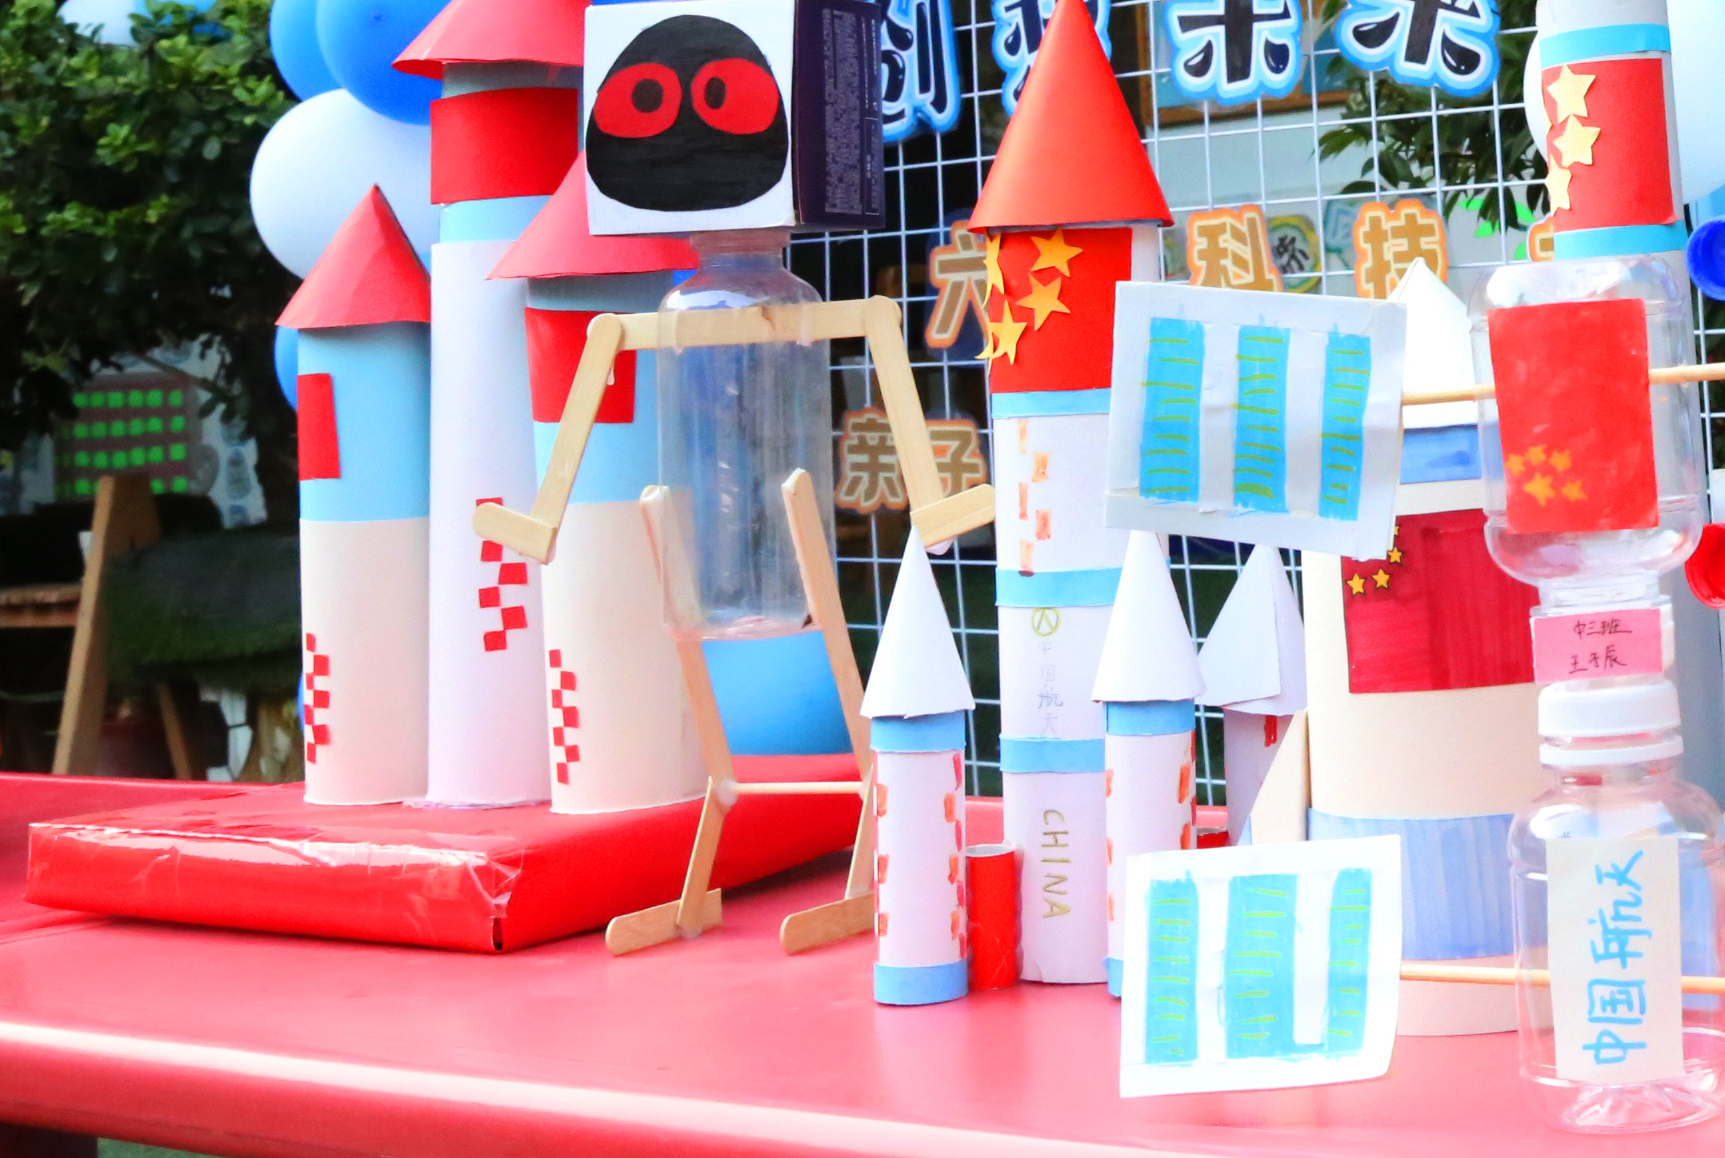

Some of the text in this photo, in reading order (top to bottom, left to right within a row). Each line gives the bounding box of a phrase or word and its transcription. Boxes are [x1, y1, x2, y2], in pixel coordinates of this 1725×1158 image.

[1040, 808, 1072, 920] CHINA
[1582, 848, 1653, 1066] 中国航天
